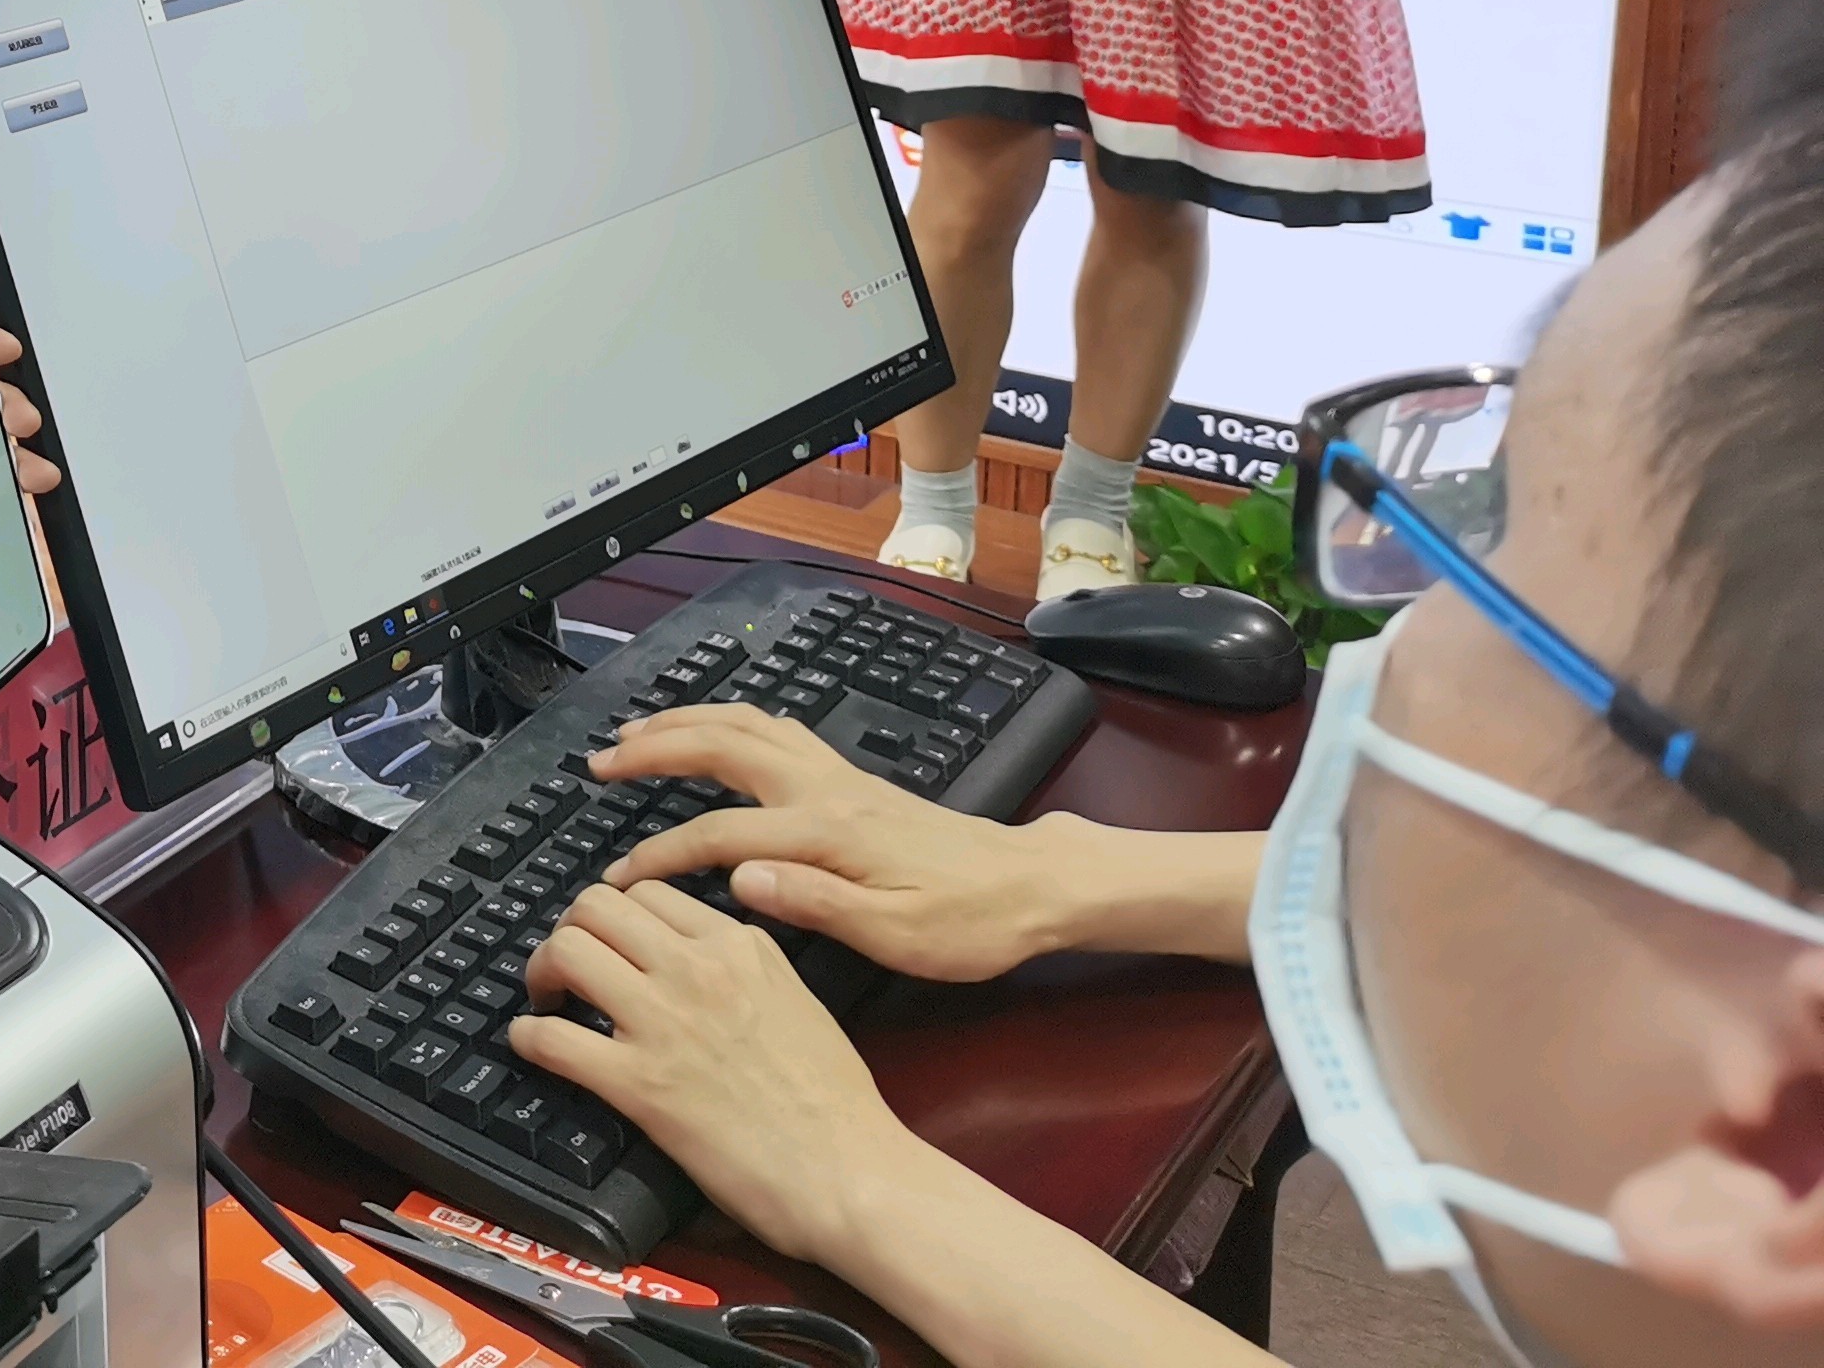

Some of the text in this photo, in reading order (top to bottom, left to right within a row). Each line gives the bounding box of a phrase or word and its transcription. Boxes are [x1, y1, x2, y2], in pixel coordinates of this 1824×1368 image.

[1197, 414, 1300, 454] 10:20
[500, 961, 519, 973] E
[473, 984, 493, 998] W
[39, 1099, 77, 1138] P1108
[479, 1224, 643, 1295] TECLAST
